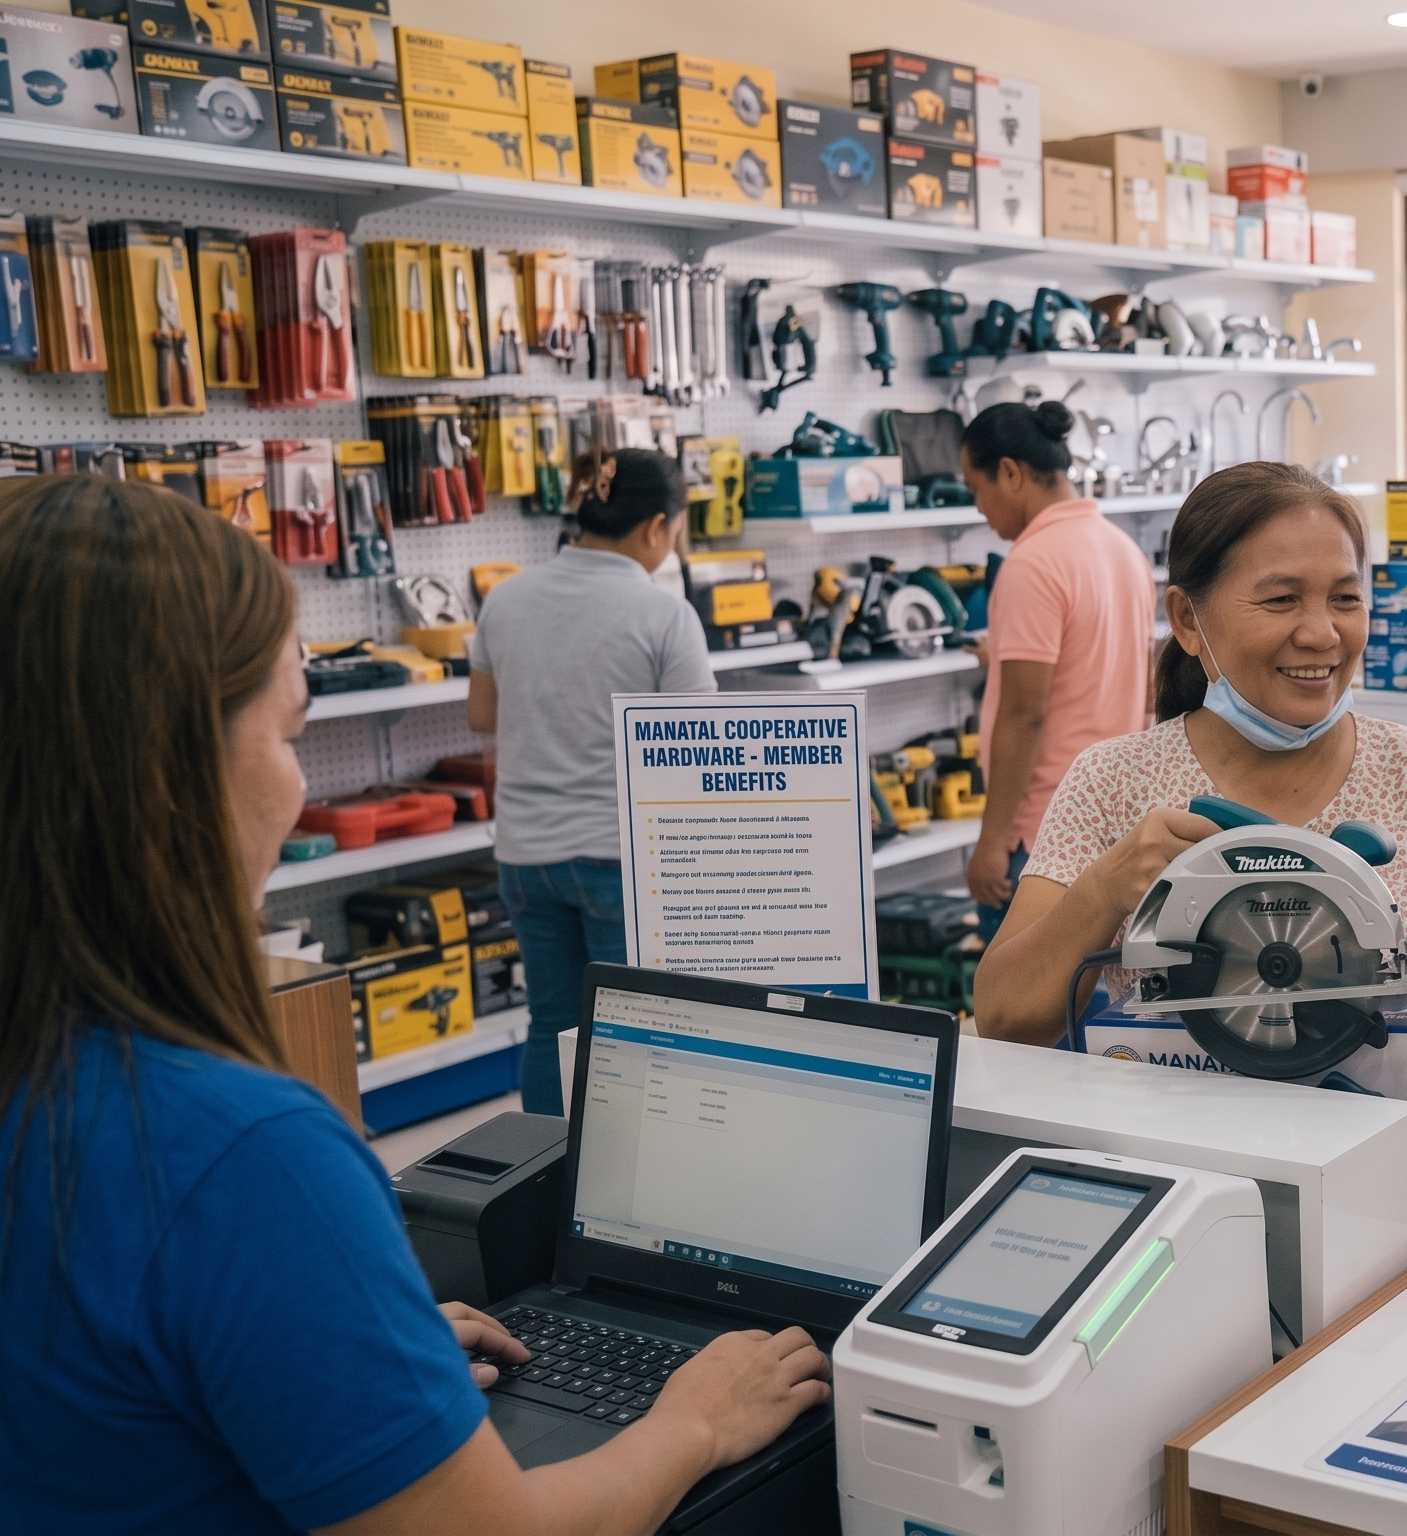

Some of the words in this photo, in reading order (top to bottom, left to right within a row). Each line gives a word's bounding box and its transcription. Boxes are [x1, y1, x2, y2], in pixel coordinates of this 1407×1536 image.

[634, 720, 720, 741] MANATAL
[724, 718, 848, 740] COOPERATIVE
[642, 746, 746, 767] HARDWARE
[763, 745, 843, 765] MEMBER
[702, 771, 787, 792] BENEFITS
[1148, 1052, 1237, 1073] MANA
